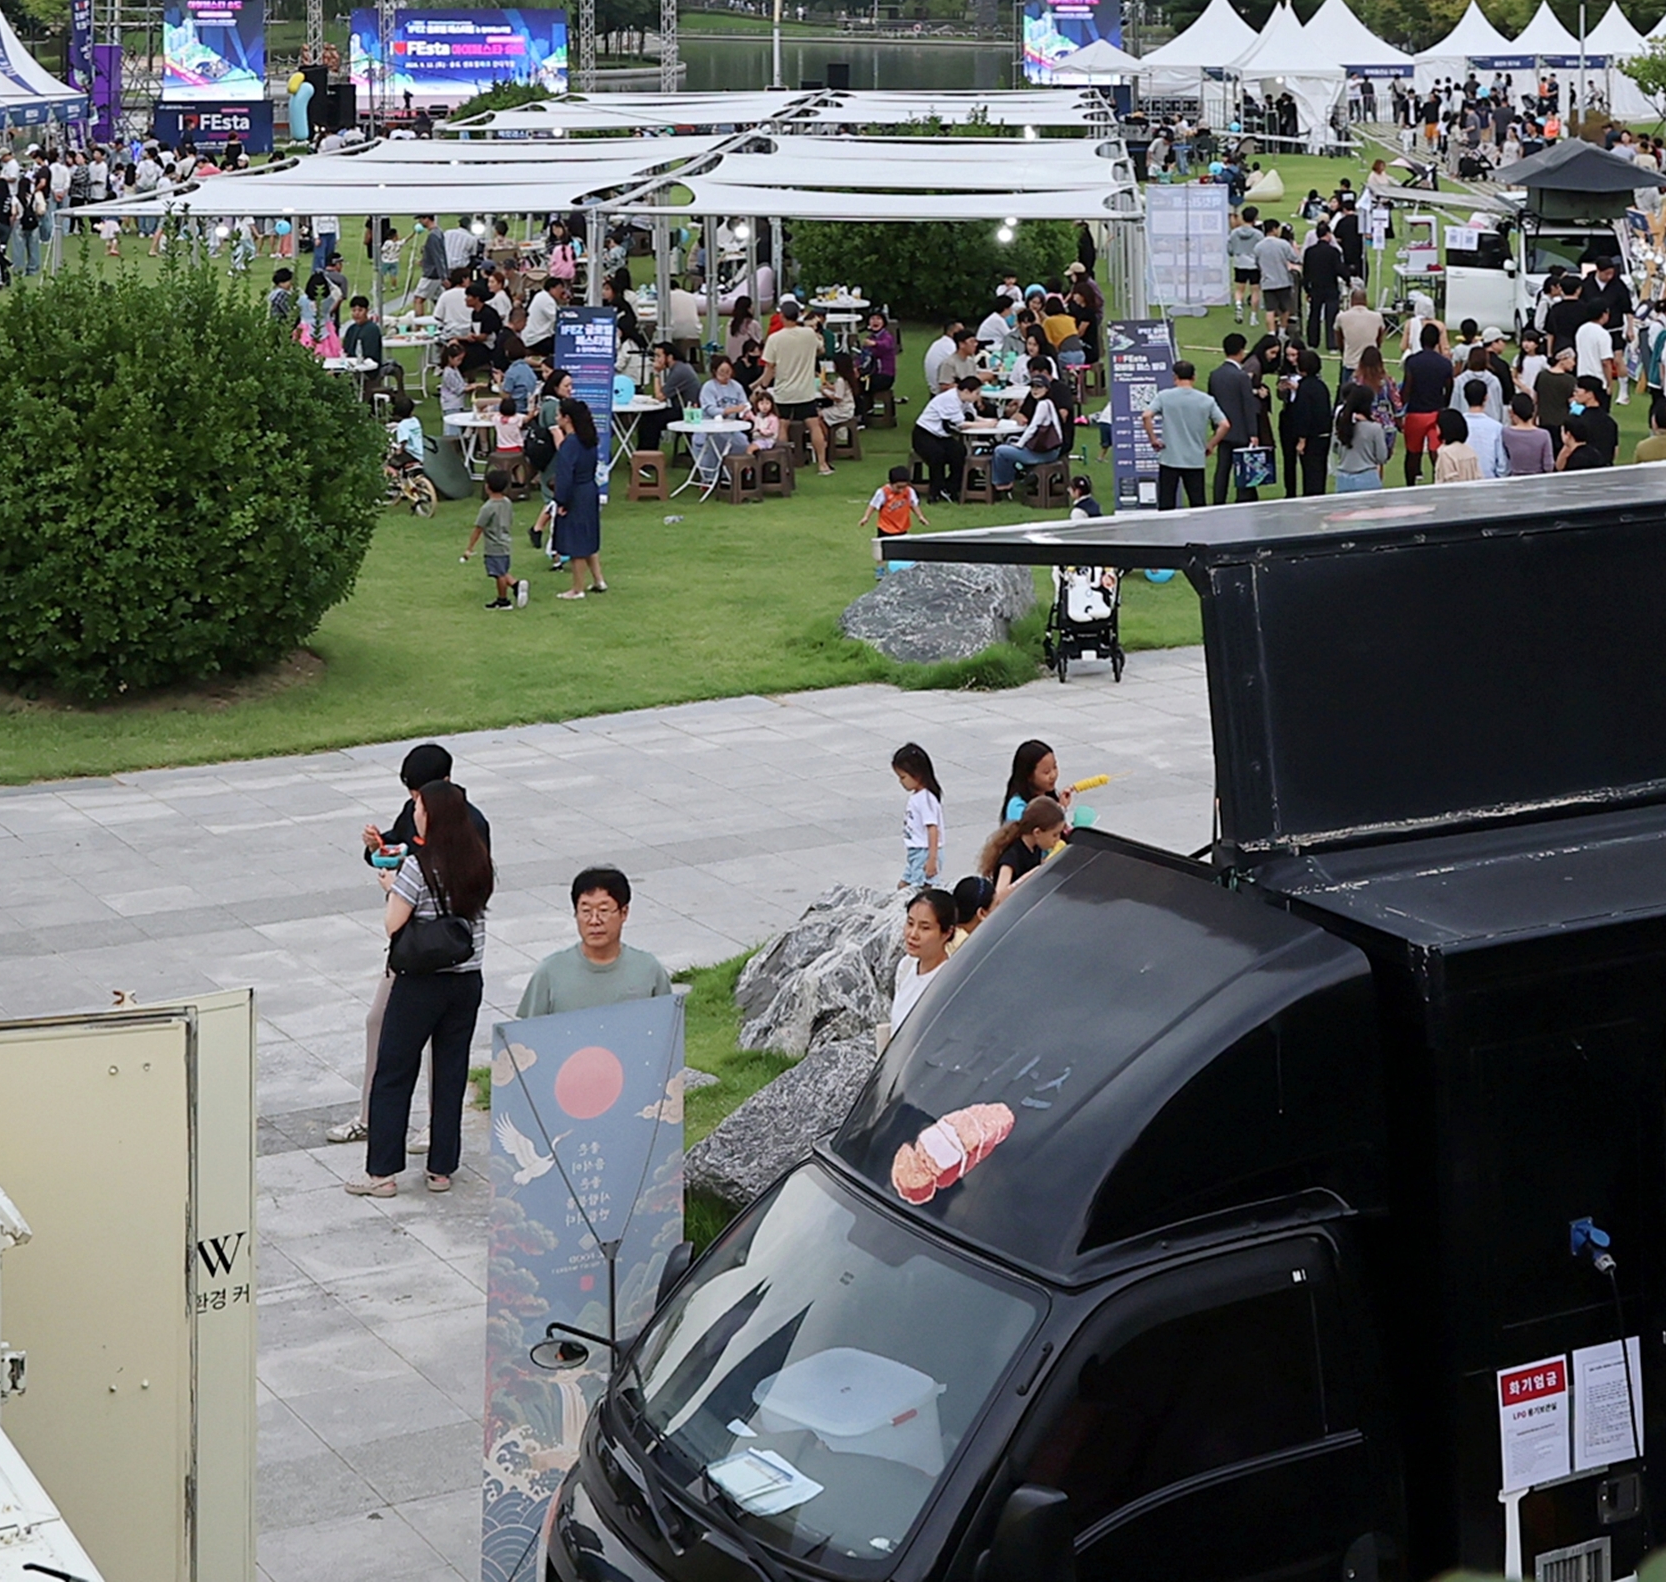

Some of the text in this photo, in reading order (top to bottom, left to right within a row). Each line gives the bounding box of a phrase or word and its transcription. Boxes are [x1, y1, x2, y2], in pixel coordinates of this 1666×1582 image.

[407, 40, 451, 56] FEsta
[178, 114, 250, 131] I FEsta
[561, 323, 614, 336] IFEZ 글로벌
[575, 335, 613, 347] 페스티벌
[1123, 354, 1147, 363] FEsta
[1509, 1370, 1557, 1396] 화기엄금
[1513, 1409, 1527, 1421] LPG
